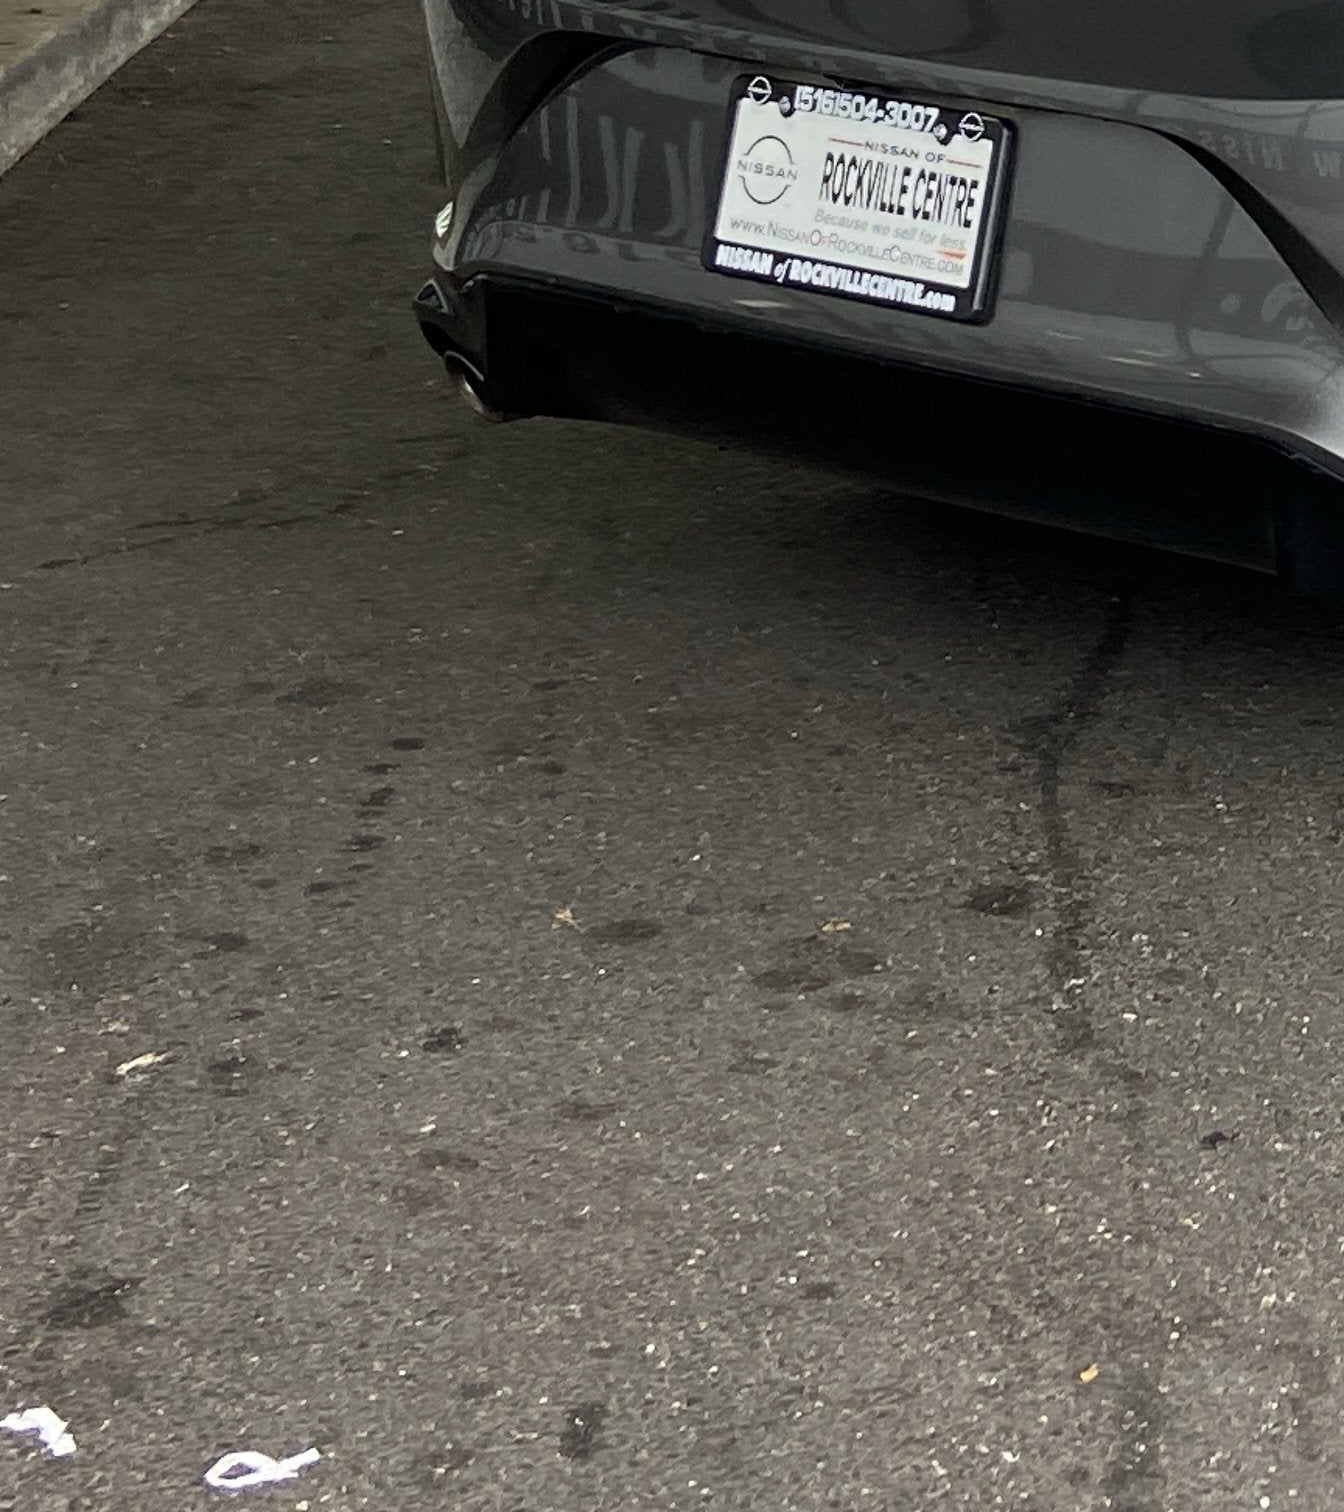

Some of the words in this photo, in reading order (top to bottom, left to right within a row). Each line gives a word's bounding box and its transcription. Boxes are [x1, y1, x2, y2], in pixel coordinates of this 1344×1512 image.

[864, 140, 920, 159] NISSAN
[925, 152, 946, 163] OF
[737, 159, 798, 181] NISSAN
[819, 152, 912, 215] ROCKVILLE
[912, 168, 979, 228] CENTRE
[814, 208, 869, 233] Because
[872, 224, 891, 235] we
[893, 226, 917, 240] sell
[919, 229, 938, 243] for
[715, 244, 774, 275] NISSAN
[774, 257, 793, 283] of
